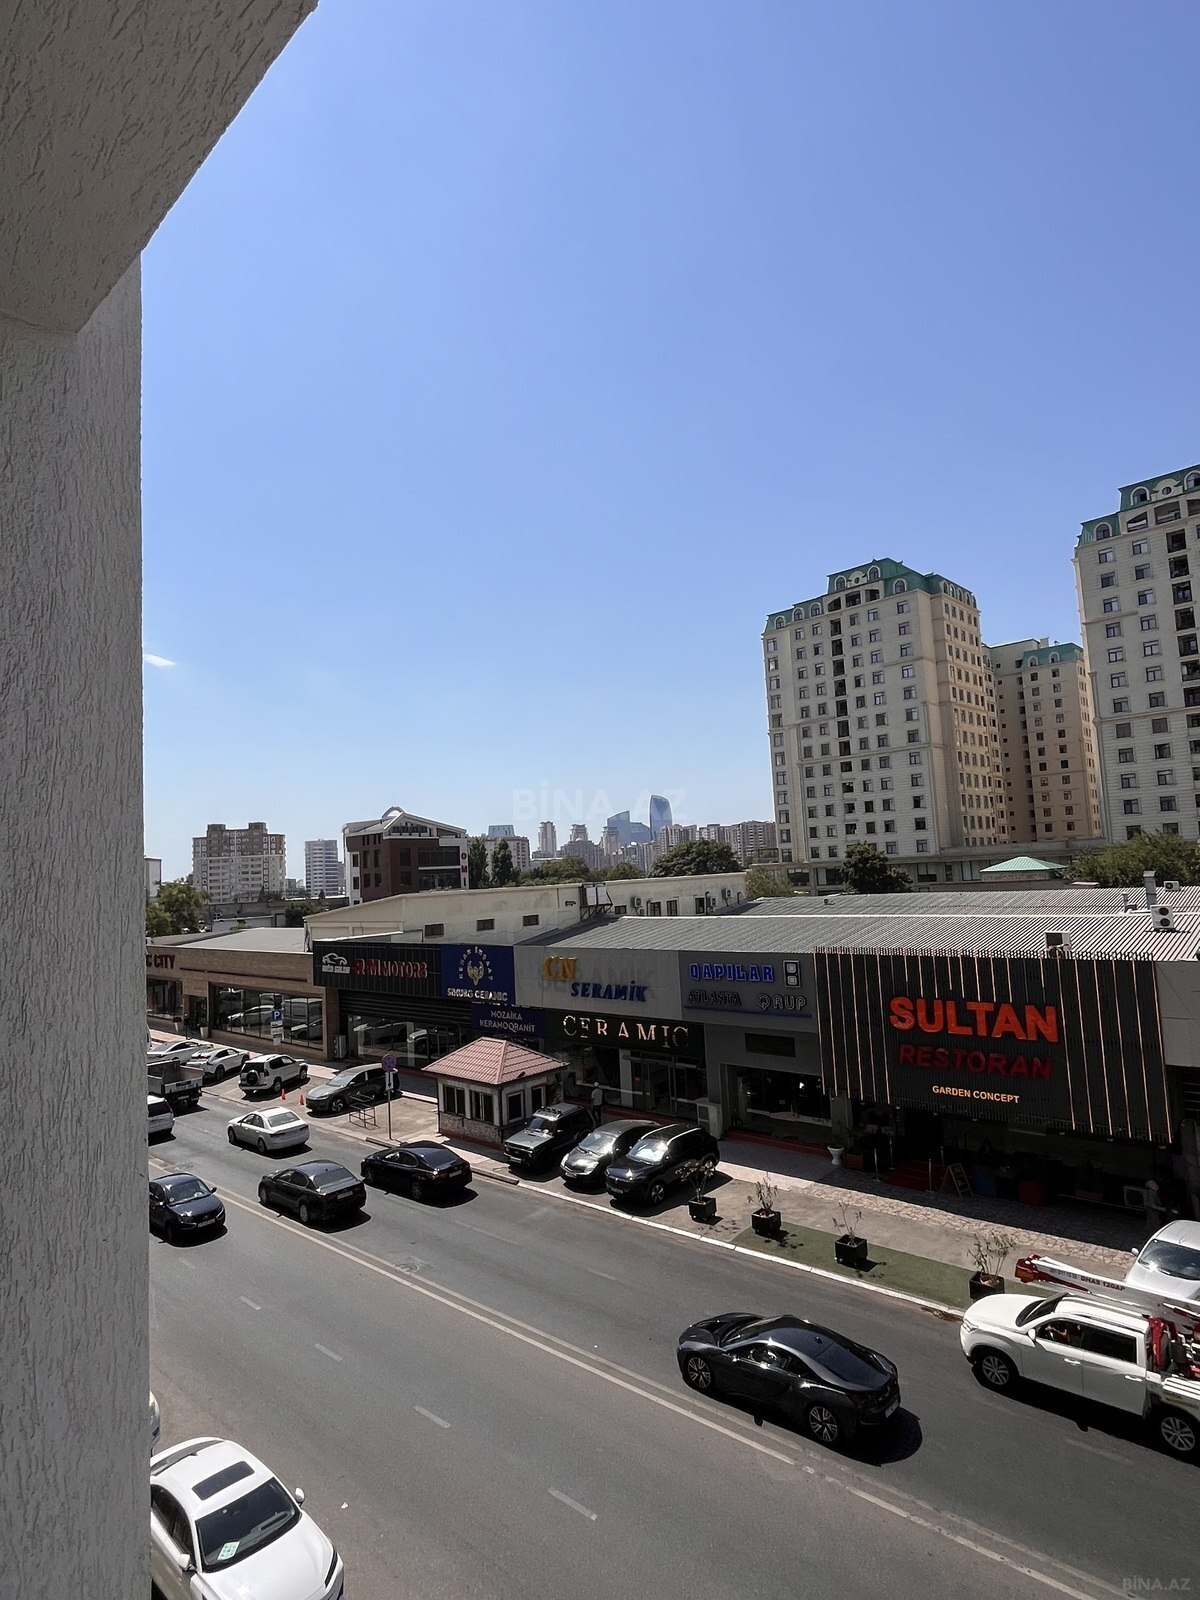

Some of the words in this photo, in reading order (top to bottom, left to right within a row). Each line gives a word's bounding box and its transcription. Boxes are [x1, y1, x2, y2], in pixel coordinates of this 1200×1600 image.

[154, 953, 175, 969] CITY
[689, 963, 774, 982] QAPILAR
[474, 990, 508, 1001] CERAMIC
[571, 980, 648, 1002] SERAMİK
[688, 989, 742, 1007] ATLANTA
[889, 996, 1060, 1042] SULTAN
[563, 1015, 689, 1048] CERAMIC
[898, 1043, 1054, 1080] RESTORAN
[932, 1084, 971, 1098] GARDEN
[972, 1089, 1020, 1103] CONCEPT
